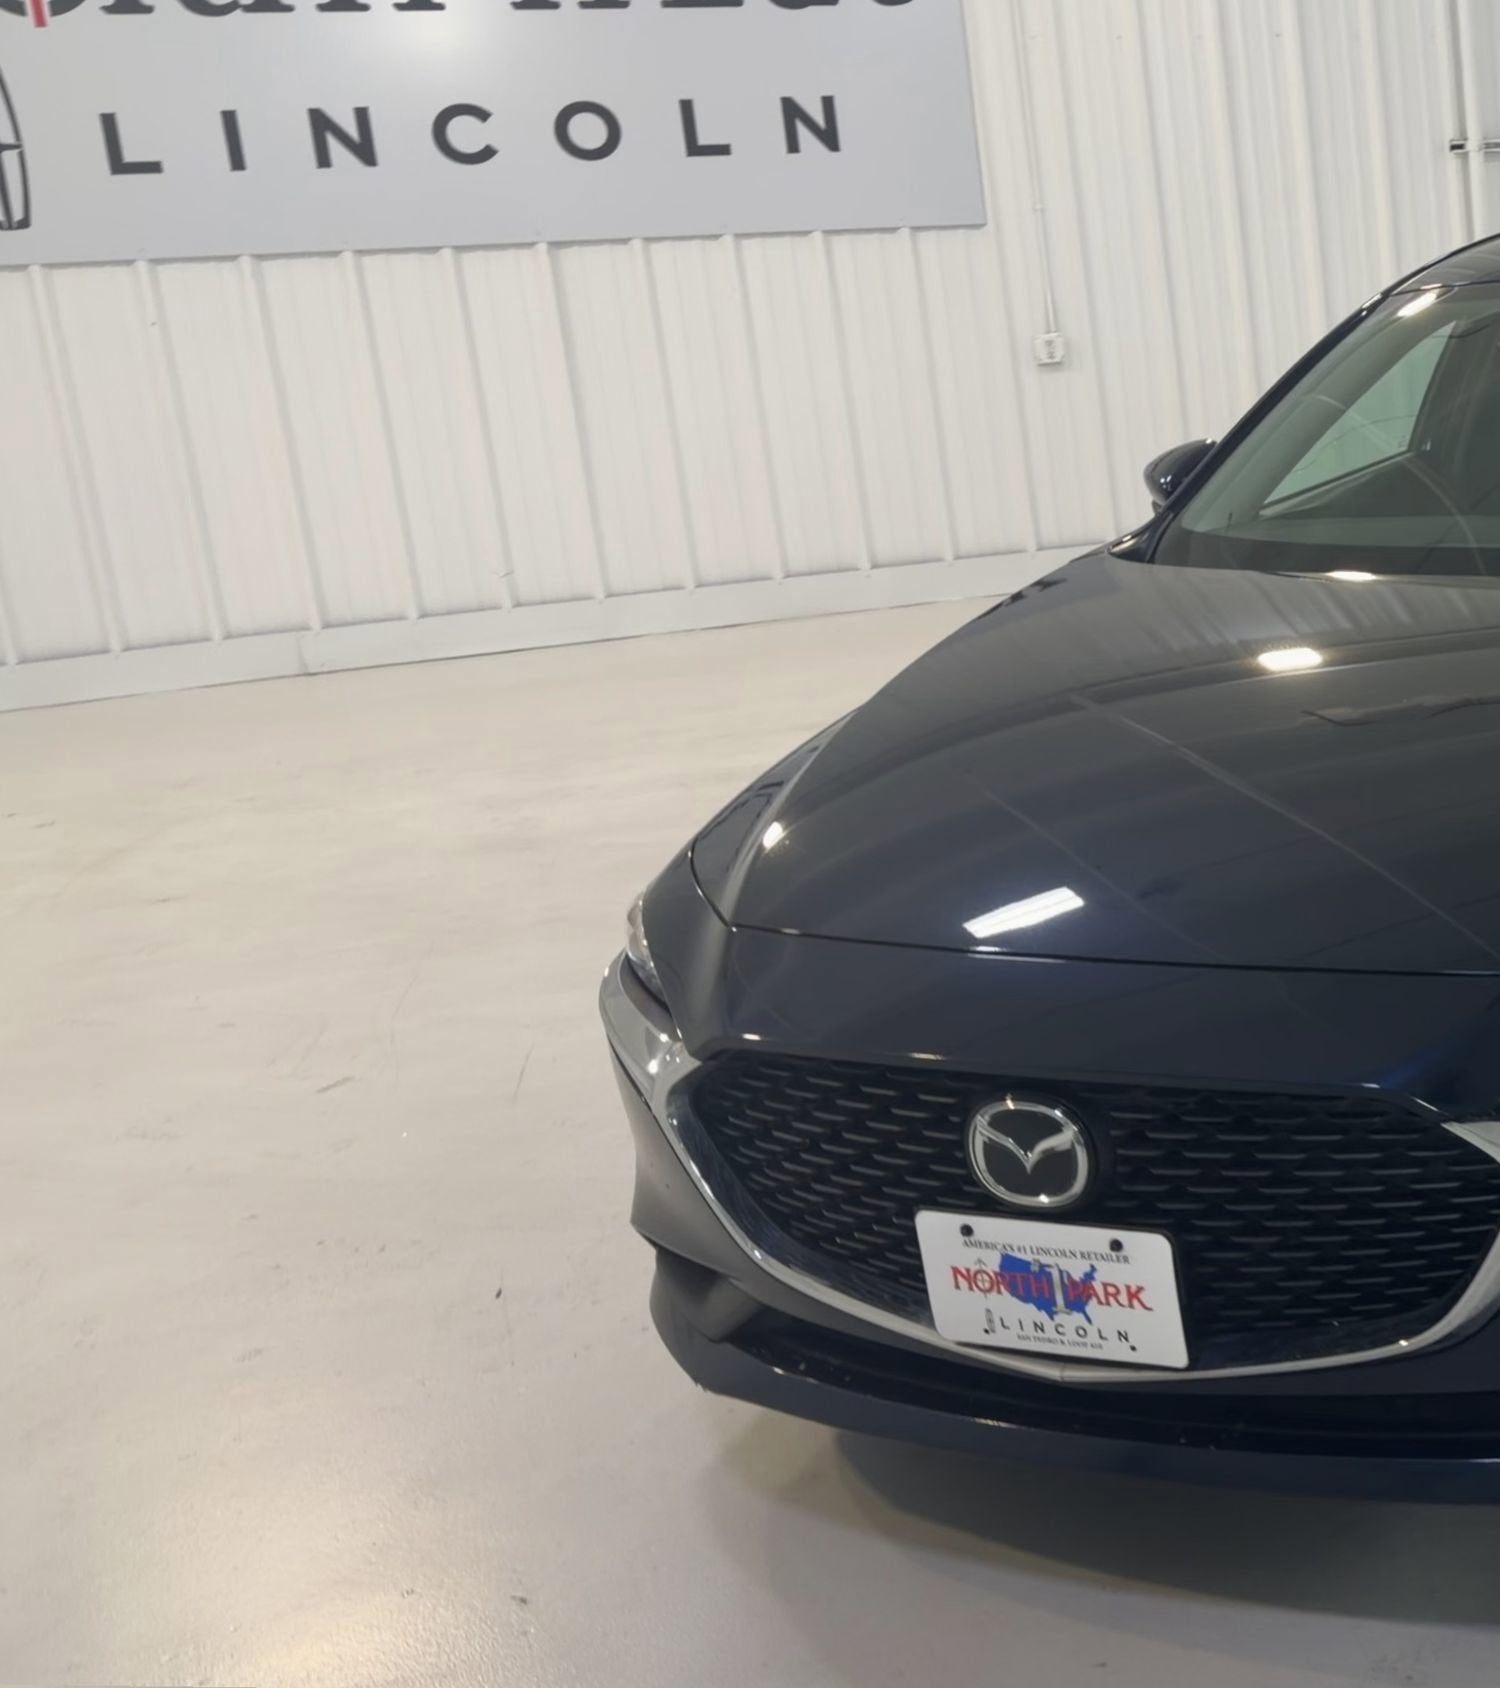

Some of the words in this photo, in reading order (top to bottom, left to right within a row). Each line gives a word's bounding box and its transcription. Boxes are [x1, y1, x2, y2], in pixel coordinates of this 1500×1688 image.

[99, 95, 843, 175] LINCOLN
[1029, 1245, 1078, 1260] LINCOLN
[1079, 1251, 1131, 1264] RETAILER
[950, 1266, 1050, 1298] NORTH
[1067, 1275, 1154, 1312] PARK
[999, 1316, 1130, 1343] LINCOLN
